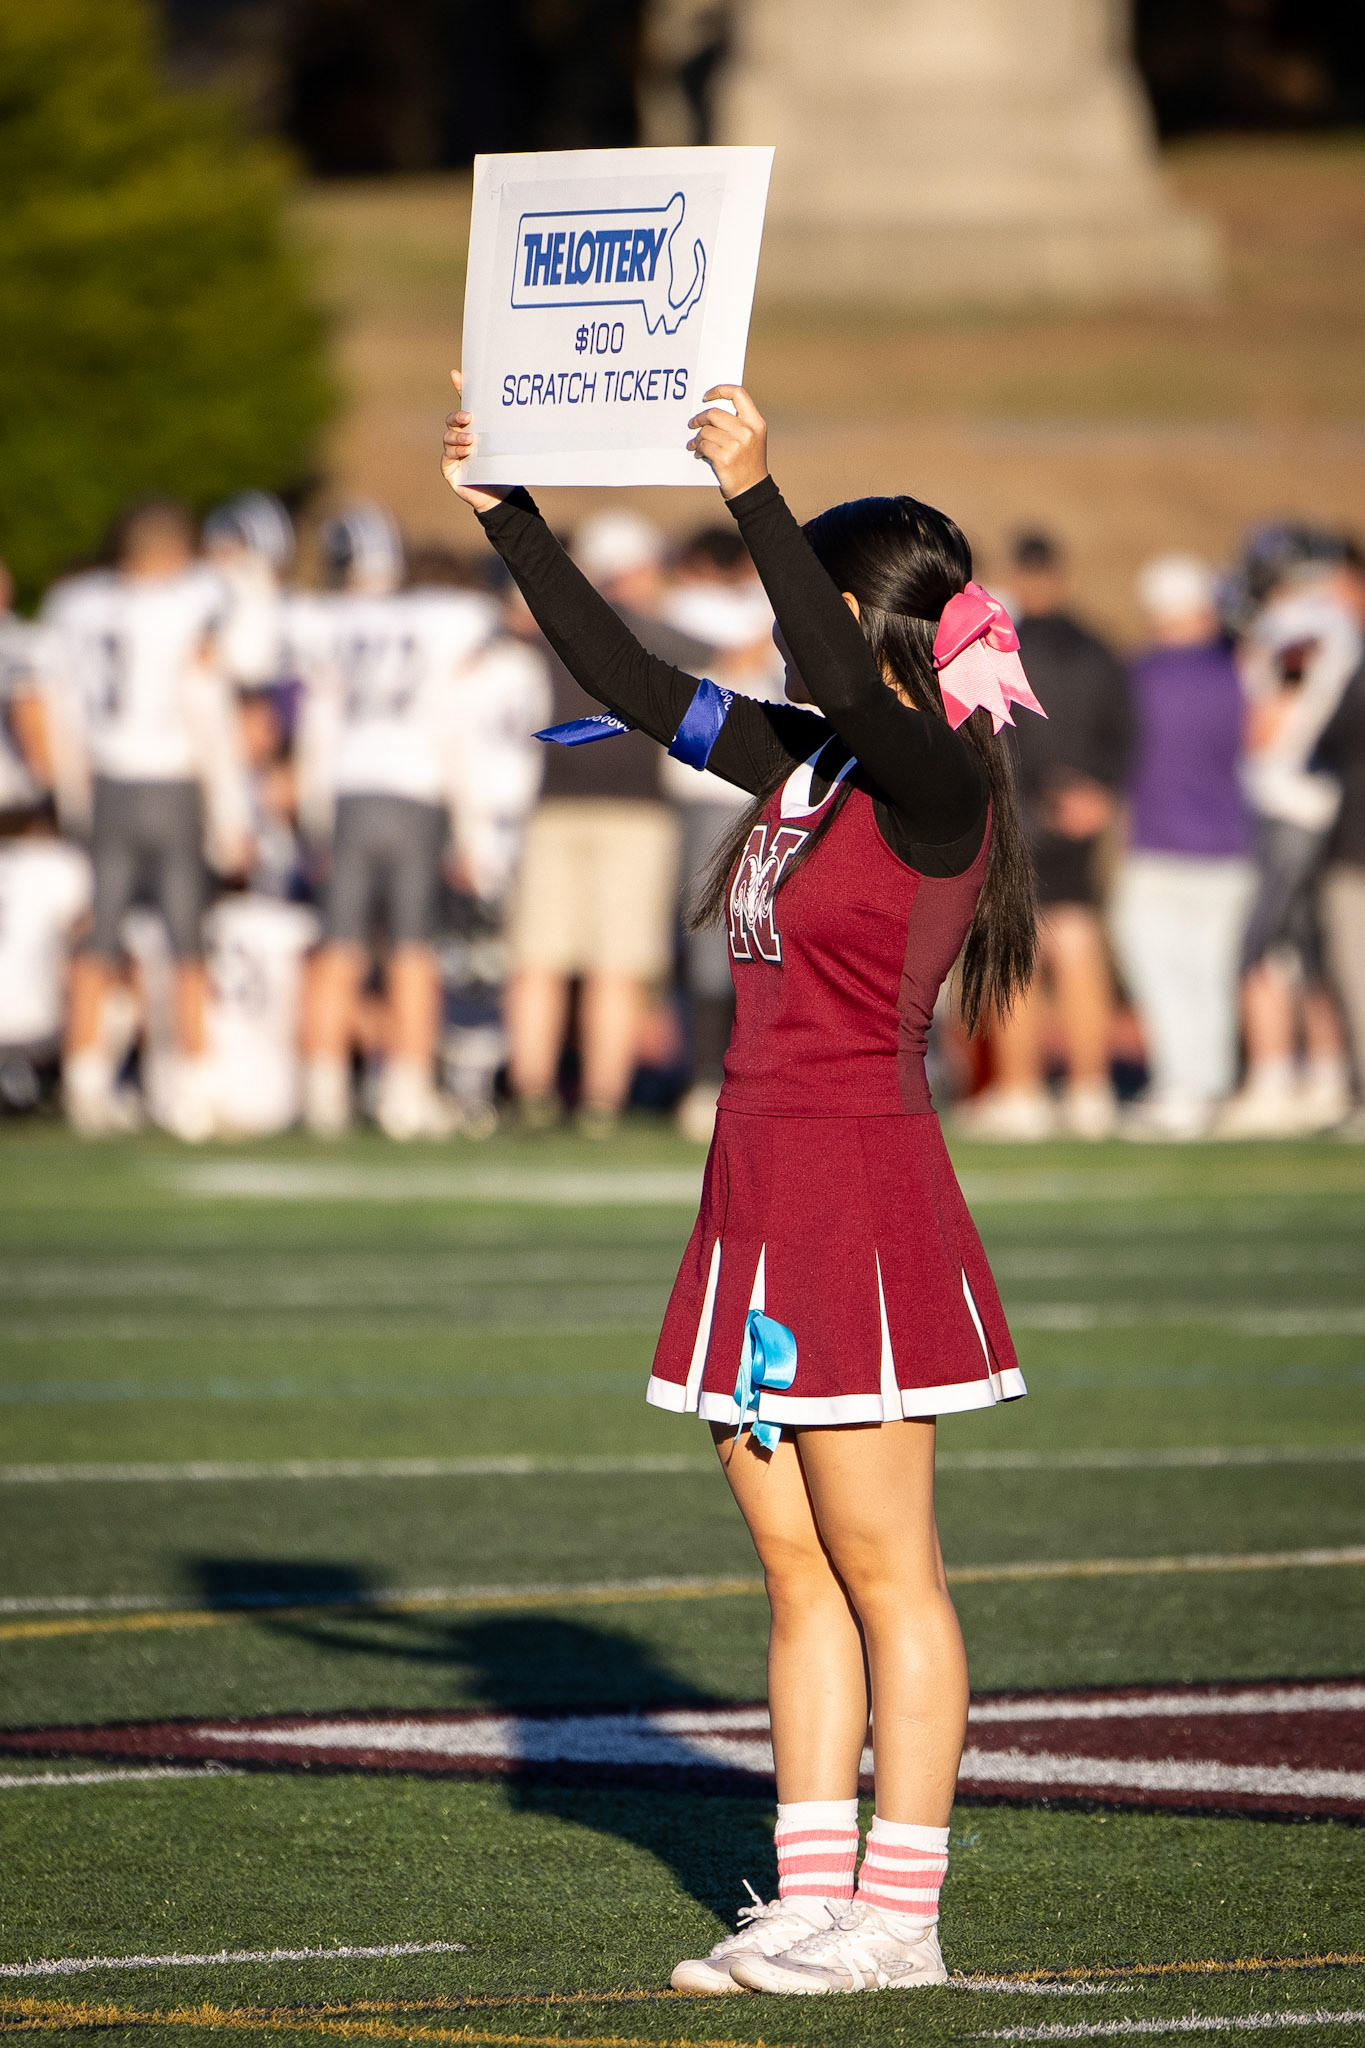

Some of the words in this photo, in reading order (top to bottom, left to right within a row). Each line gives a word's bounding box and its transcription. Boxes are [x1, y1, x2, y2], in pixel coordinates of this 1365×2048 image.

[575, 321, 625, 355] $100
[502, 371, 598, 407] SCRATCH
[603, 368, 689, 403] TICKETS
[729, 821, 814, 966] N
